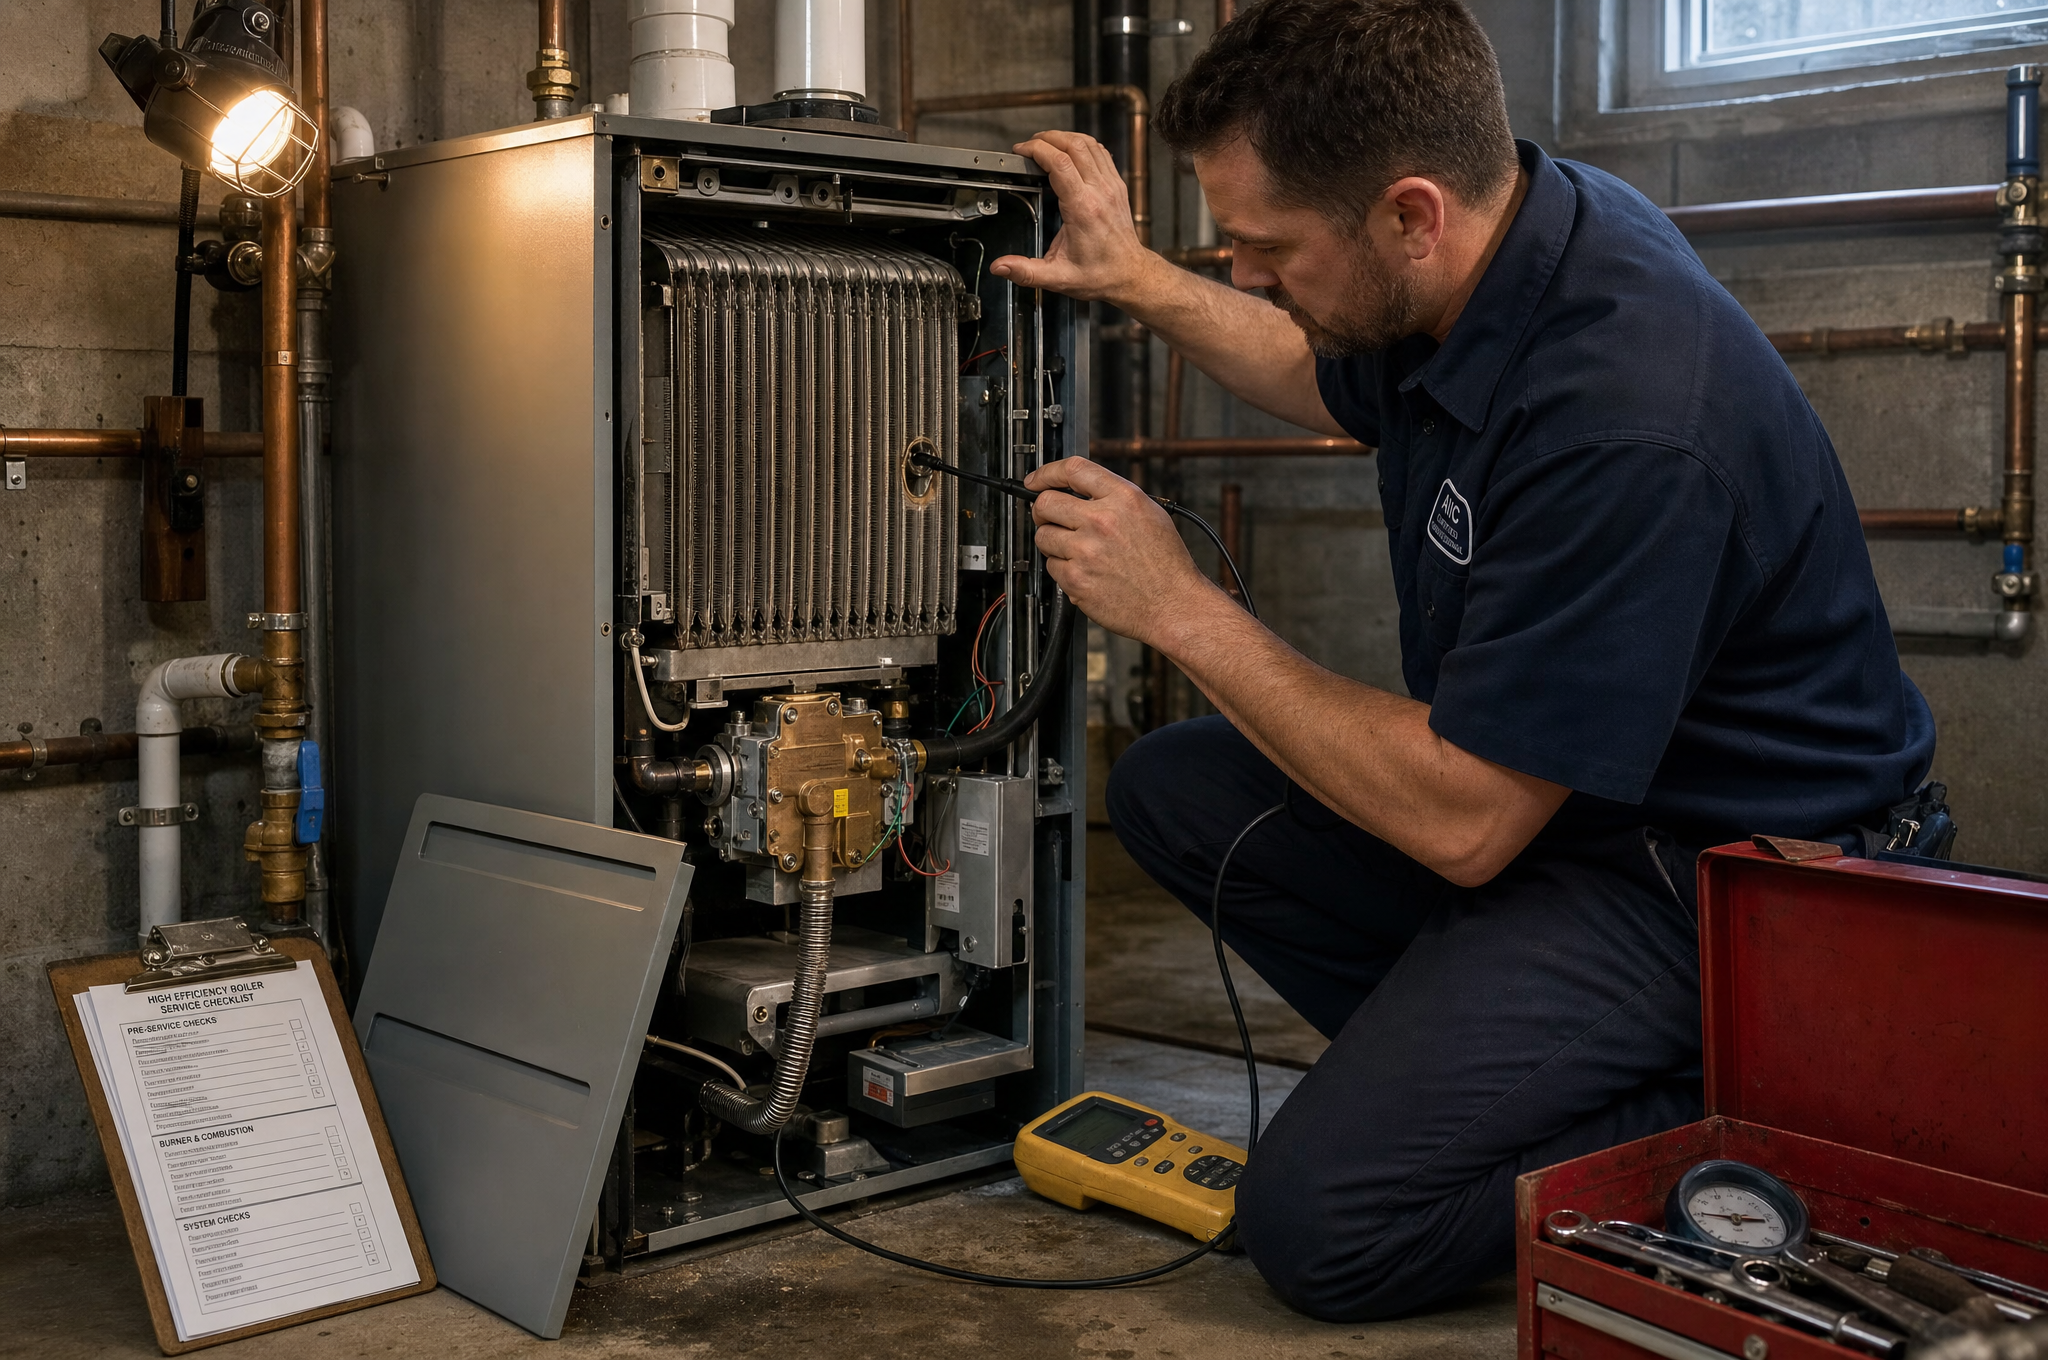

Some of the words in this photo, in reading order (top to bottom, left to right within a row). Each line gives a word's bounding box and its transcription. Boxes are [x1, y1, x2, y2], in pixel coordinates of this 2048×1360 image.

[147, 993, 172, 1004] HIGH
[174, 986, 228, 1001] EFFICIENCY
[231, 981, 265, 993] BOILER
[160, 999, 201, 1014] SERVICE
[203, 993, 254, 1008] CHECKLIST
[127, 1021, 182, 1035] PRE-SERVICE
[183, 1016, 218, 1028] CHECKS
[159, 1136, 193, 1148] BURNER
[194, 1134, 200, 1142] &
[201, 1125, 254, 1141] COMBUSTION
[183, 1219, 216, 1231] SYSTEM
[217, 1211, 251, 1225] CHECKS
